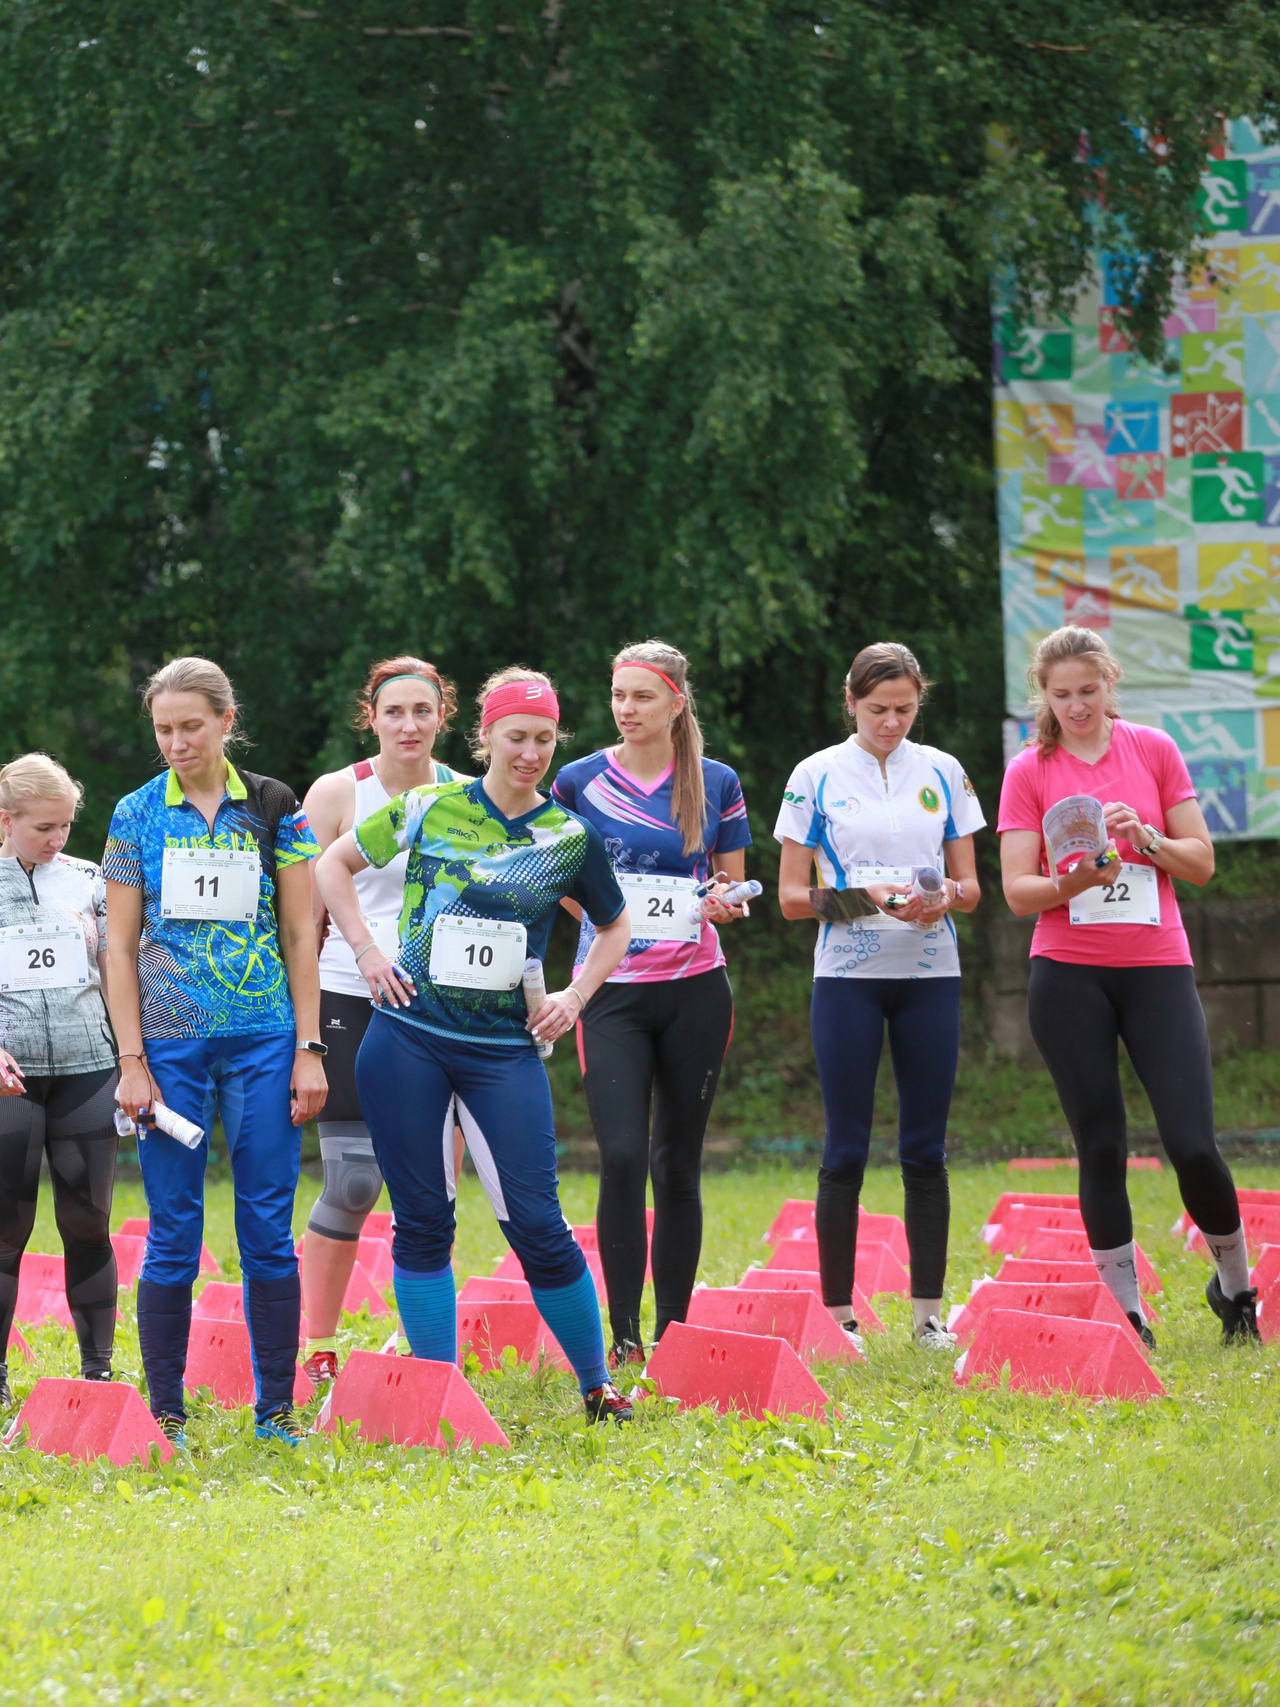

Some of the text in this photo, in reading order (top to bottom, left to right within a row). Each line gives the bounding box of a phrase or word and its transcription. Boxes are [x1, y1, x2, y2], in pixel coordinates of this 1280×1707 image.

[194, 875, 219, 898] 11
[1101, 882, 1131, 903] 22
[647, 897, 675, 917] 24
[27, 947, 56, 969] 26
[464, 943, 494, 967] 10
